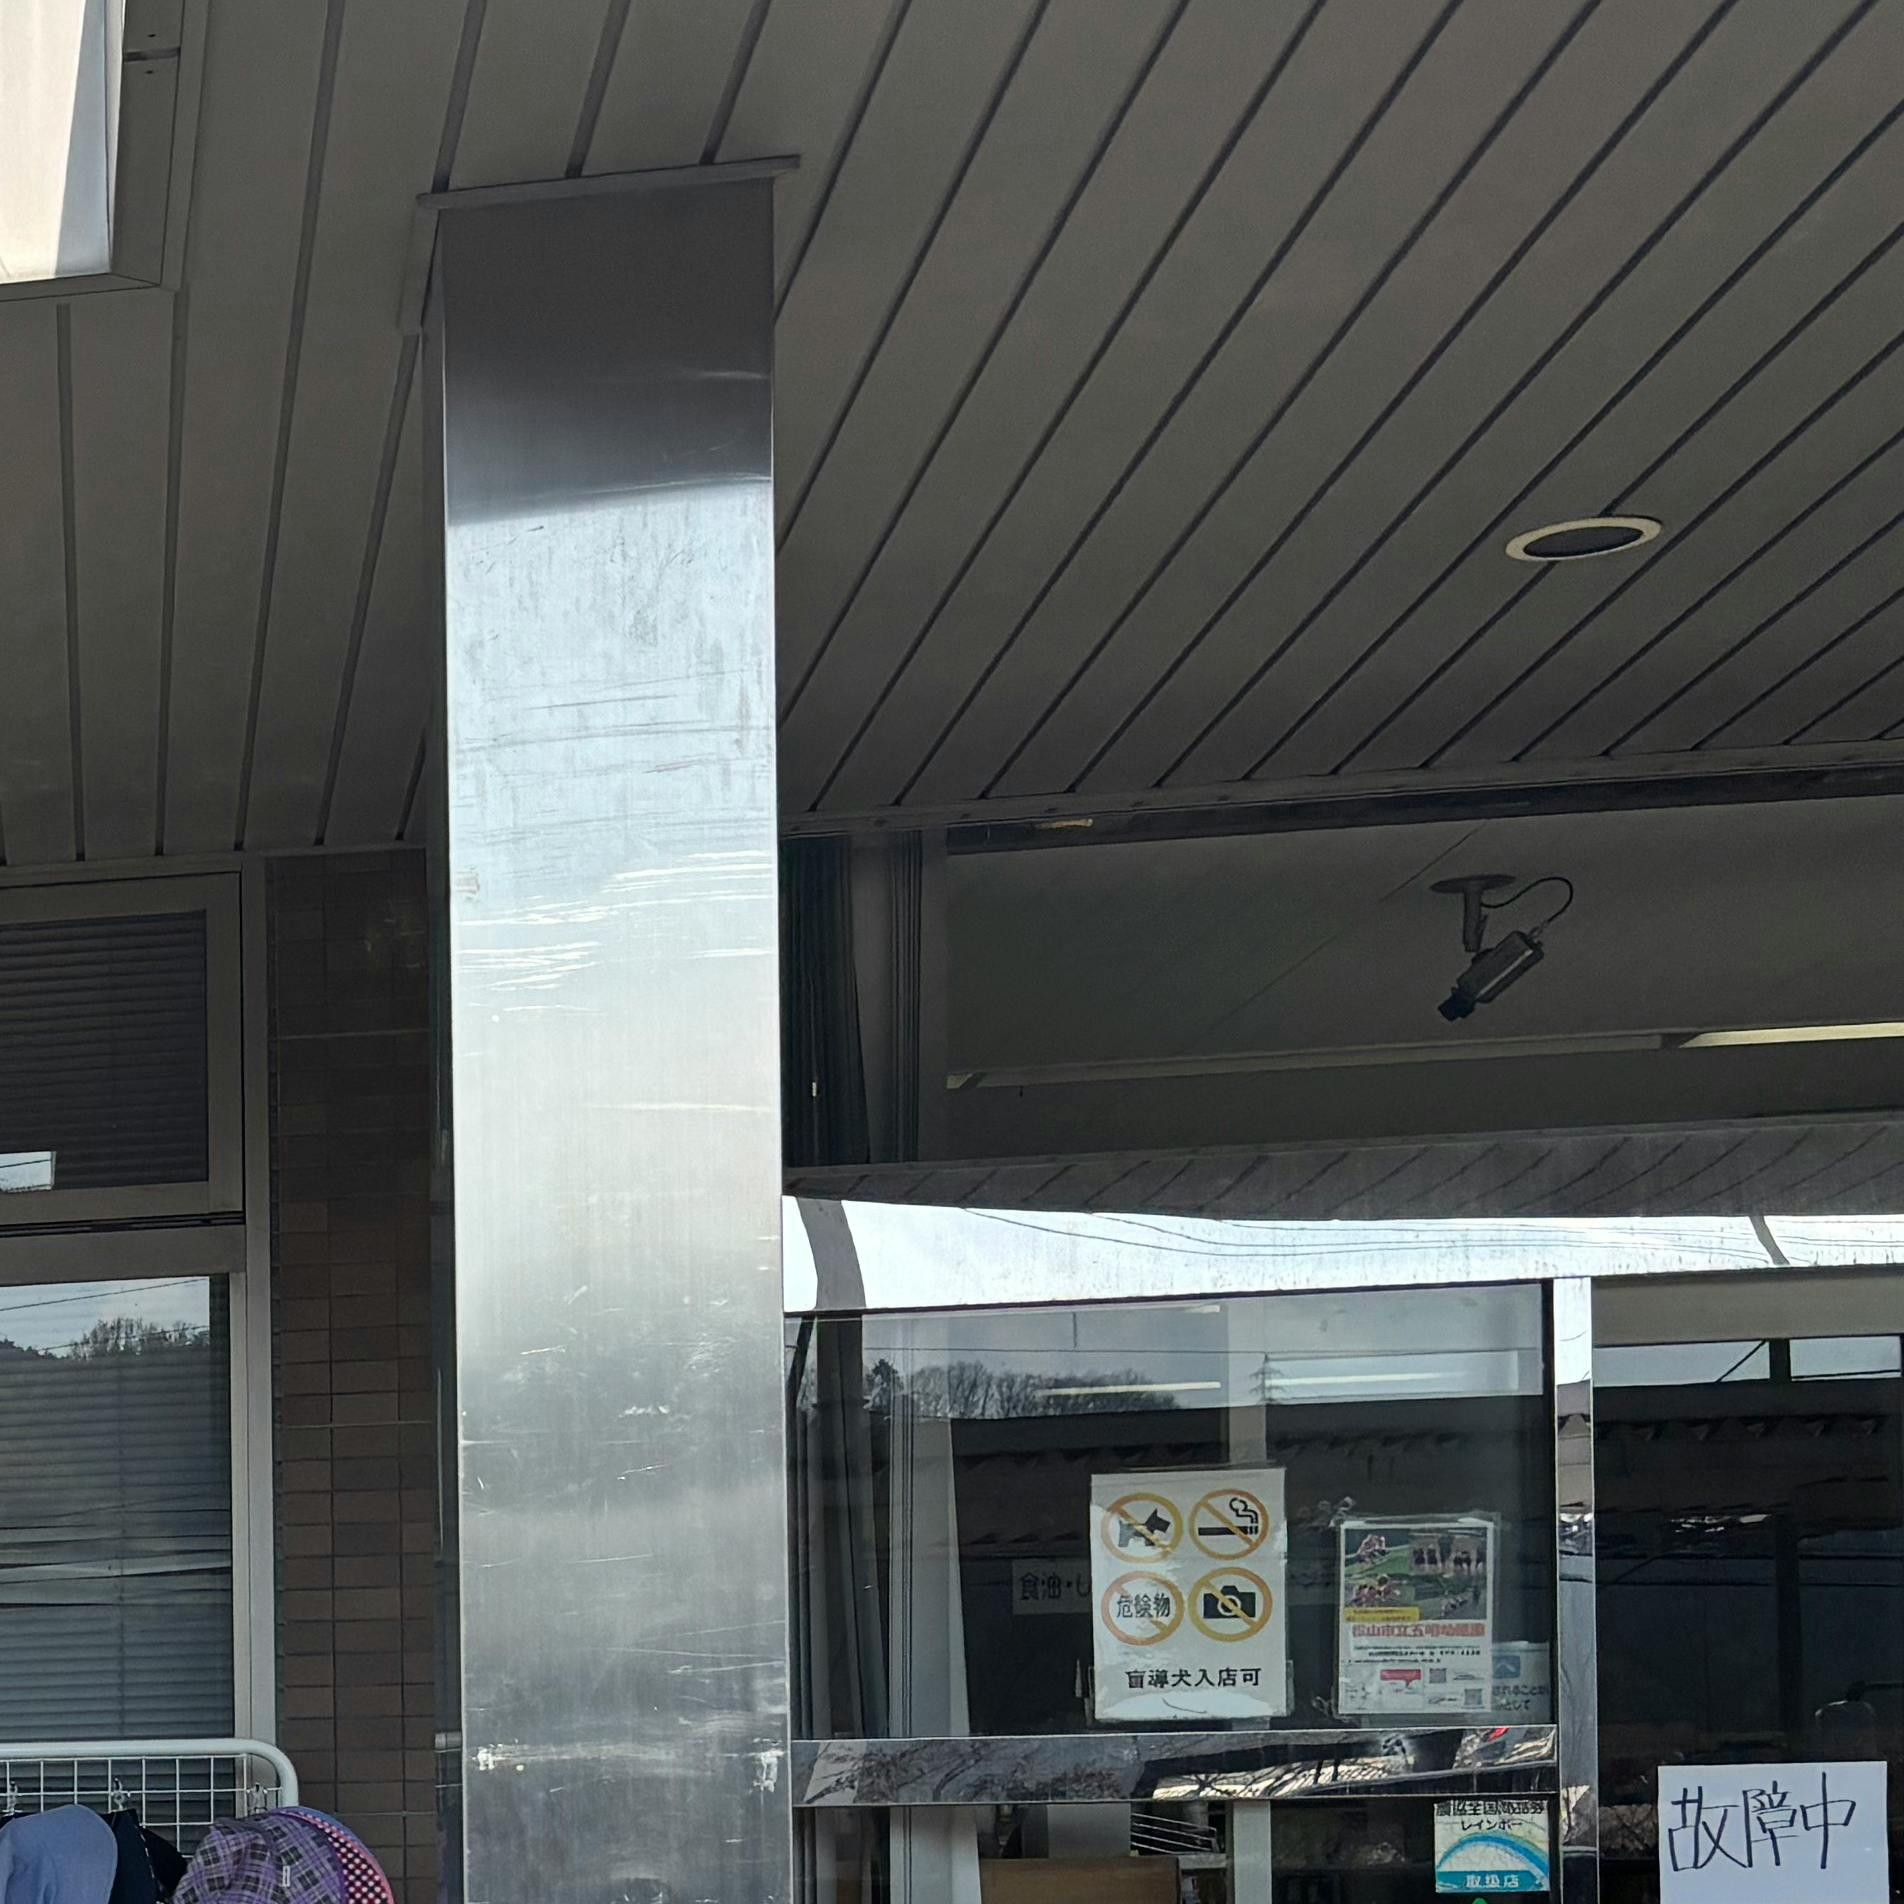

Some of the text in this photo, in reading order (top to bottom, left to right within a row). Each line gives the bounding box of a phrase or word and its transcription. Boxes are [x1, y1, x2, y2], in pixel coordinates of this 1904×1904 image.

[1115, 1593, 1171, 1619] 危険物
[1125, 1667, 1262, 1689] 盲導犬入店可
[1668, 1771, 1857, 1872] 故障中
[1465, 1873, 1520, 1889] 取扱店
